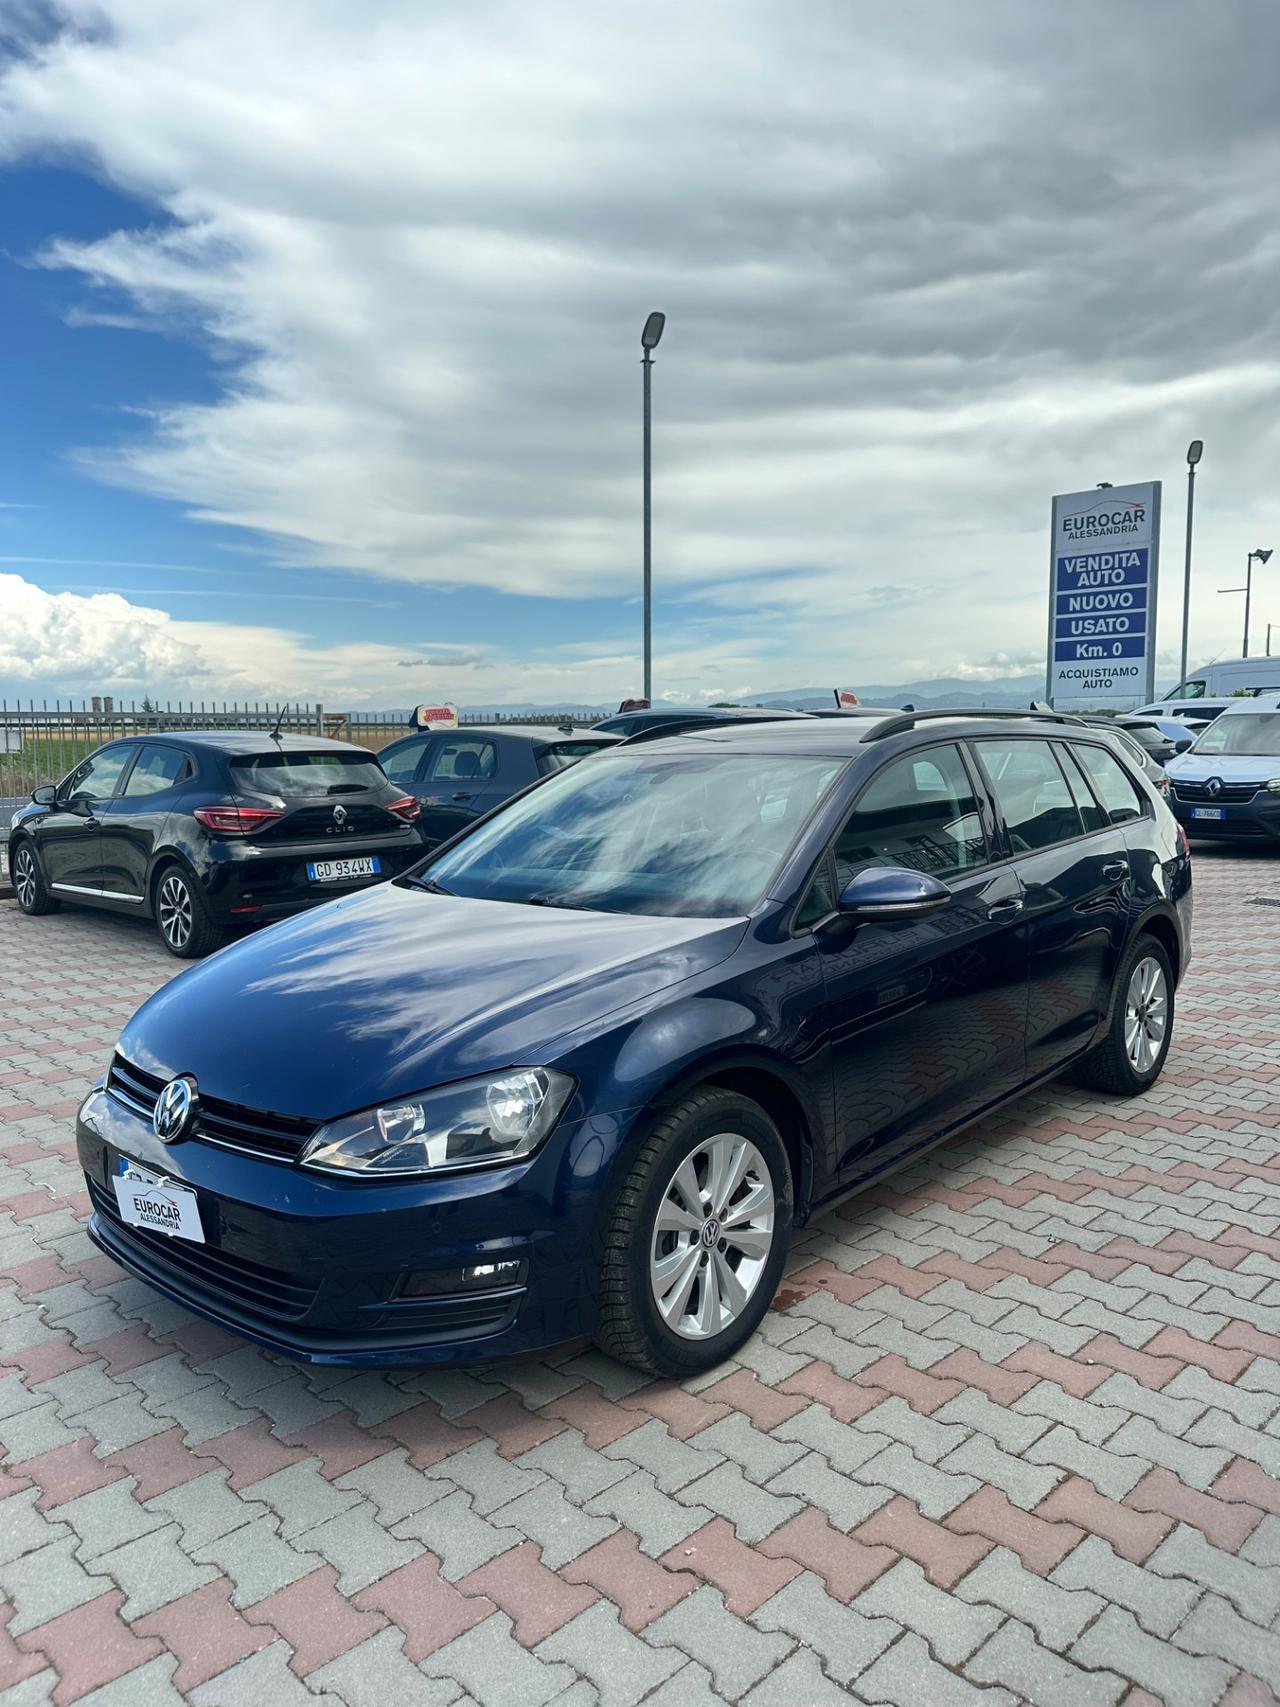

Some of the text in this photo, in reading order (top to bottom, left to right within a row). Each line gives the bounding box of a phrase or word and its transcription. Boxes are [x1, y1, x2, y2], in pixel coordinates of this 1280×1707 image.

[1063, 509, 1145, 532] EUROCAR
[1068, 523, 1138, 540] ALESSANDRIA
[1064, 551, 1140, 574] VENDITA
[1077, 568, 1125, 587] AUTO
[1069, 592, 1133, 611] NUOVO
[1071, 617, 1129, 635] USATO
[1076, 641, 1122, 658] Km. 0
[1059, 666, 1138, 680] ACQUISTIAMO
[1083, 679, 1112, 689] AUTO
[326, 825, 355, 833] CLIO
[316, 858, 373, 877] GD 934WX
[133, 1198, 181, 1222] EUROCAR
[140, 1212, 180, 1230] ALESSANDRIA
